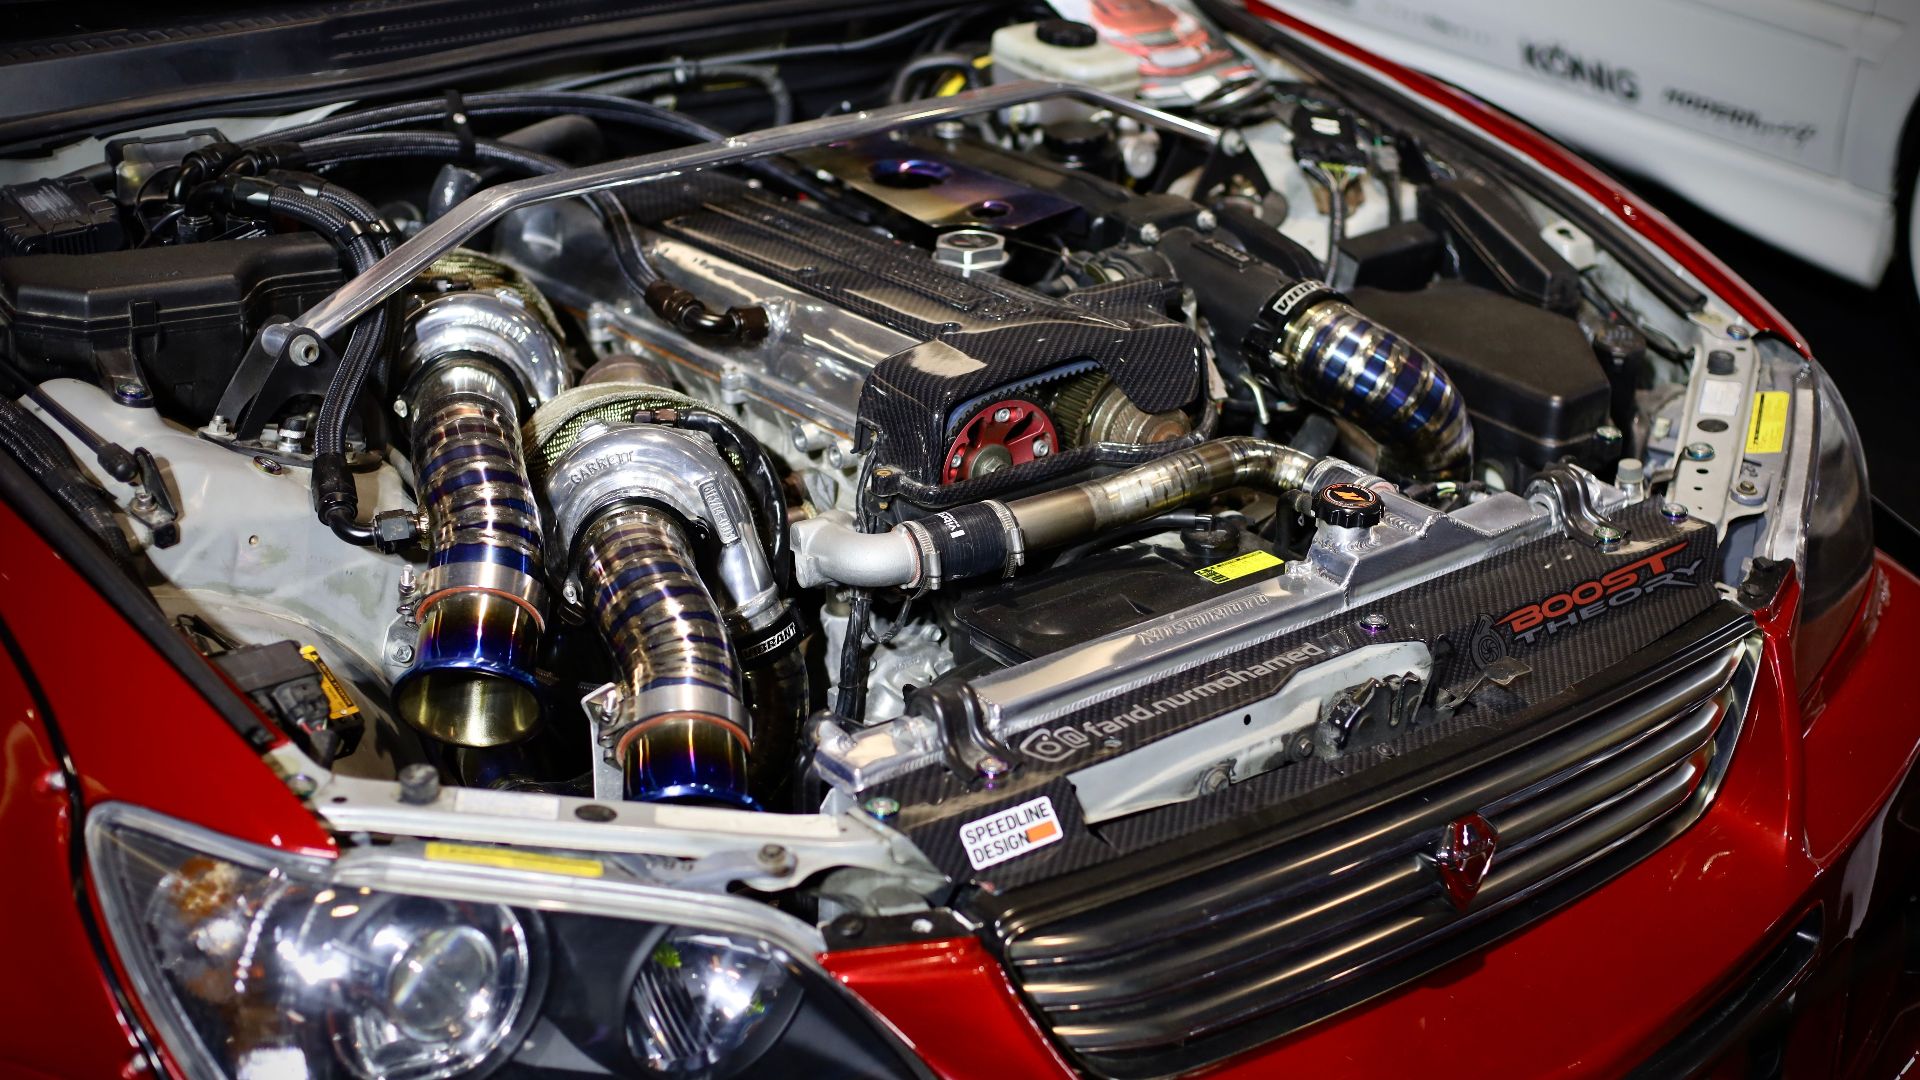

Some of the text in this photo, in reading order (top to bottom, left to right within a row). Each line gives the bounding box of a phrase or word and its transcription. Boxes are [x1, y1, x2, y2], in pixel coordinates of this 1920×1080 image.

[1522, 42, 1640, 101] KÖNIG
[570, 450, 635, 484] GARRETT
[1494, 541, 1688, 633] BOOST
[1515, 559, 1702, 644] THEORY
[1136, 593, 1269, 646] MISHIMOTO
[965, 802, 1050, 844] SPEEDLINE
[973, 832, 1031, 863] DESIGN
